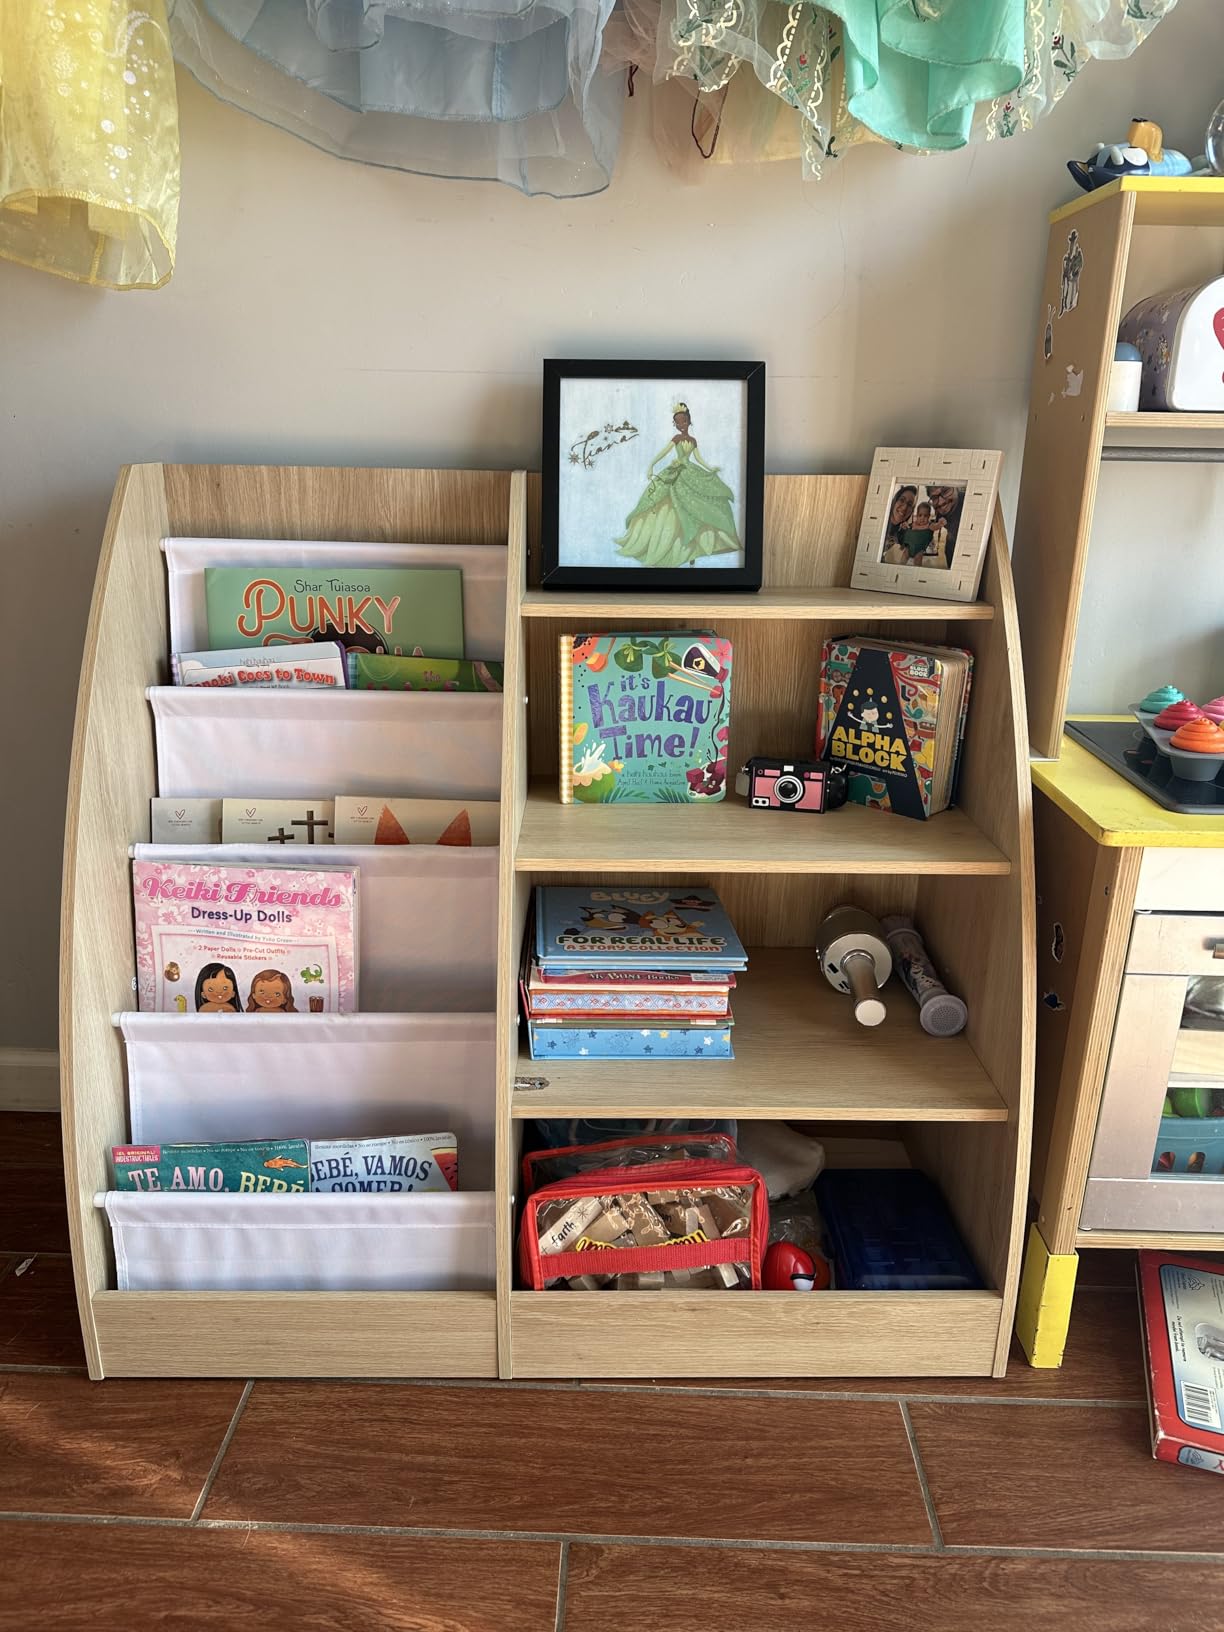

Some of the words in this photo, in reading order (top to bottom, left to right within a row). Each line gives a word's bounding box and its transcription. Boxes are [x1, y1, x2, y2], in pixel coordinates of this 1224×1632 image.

[294, 579, 322, 593] Shar
[326, 578, 371, 593] Tuiasoa
[237, 578, 400, 638] PUNKY
[237, 670, 272, 683] Goes
[275, 668, 291, 682] to
[294, 668, 336, 686] Town
[620, 673, 650, 692] it's
[587, 680, 712, 729] Kaukau
[599, 725, 700, 760] Time!
[832, 726, 907, 755] ALPHA
[832, 740, 907, 772] BLOCK
[143, 877, 221, 902] Keiki
[225, 882, 342, 907] Friends
[191, 907, 252, 924] Dress-Up
[257, 910, 292, 923] Dolls
[557, 936, 605, 945] FOR
[610, 936, 670, 945] REAL
[674, 936, 726, 946] LIFE
[128, 1167, 161, 1192] TE
[311, 1152, 358, 1182] EBÉ,
[363, 1154, 432, 1181] VAMOS
